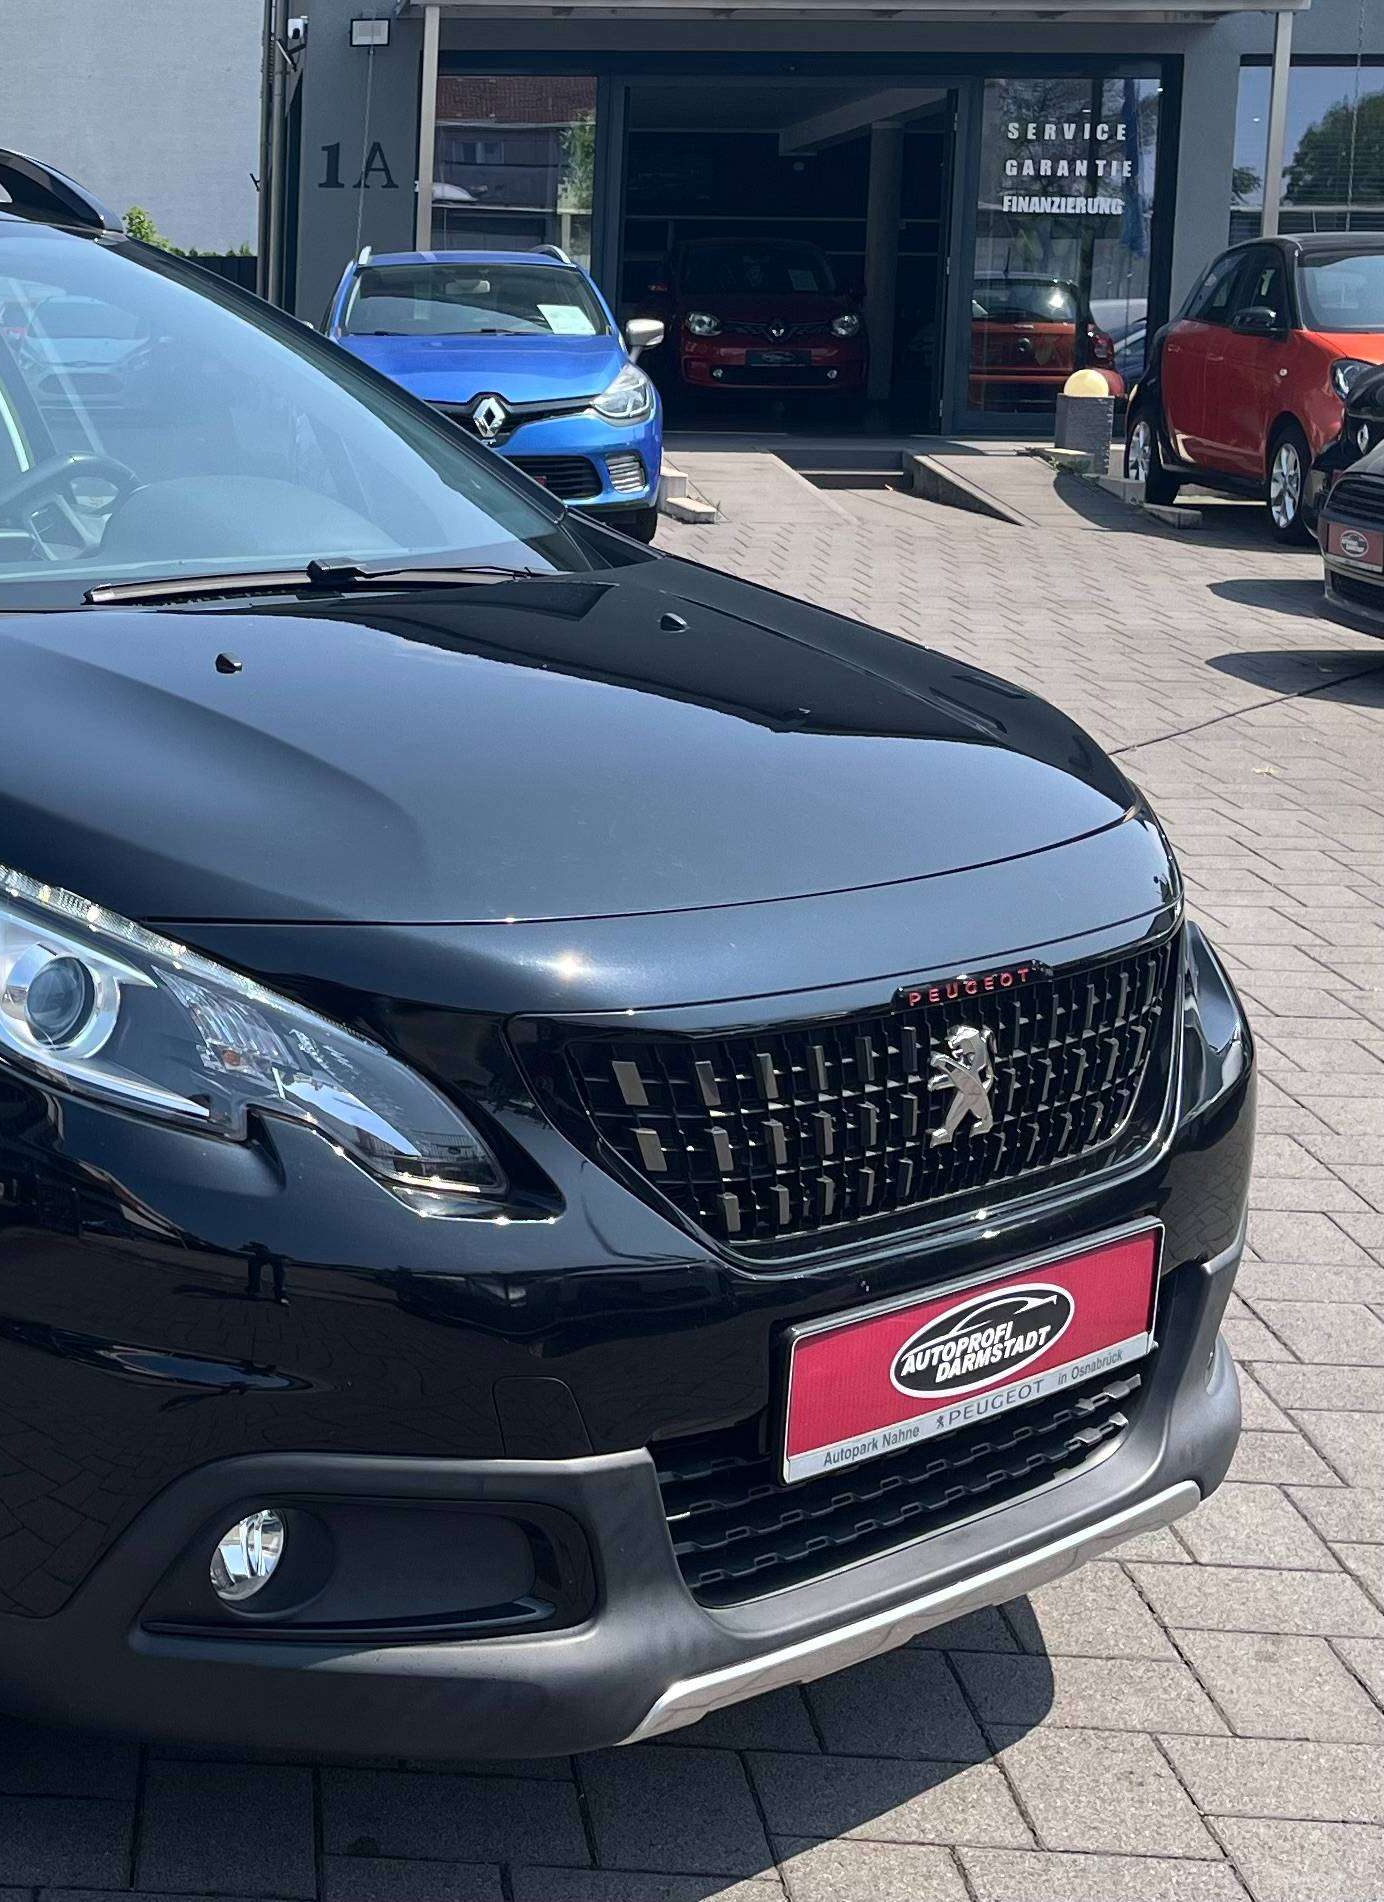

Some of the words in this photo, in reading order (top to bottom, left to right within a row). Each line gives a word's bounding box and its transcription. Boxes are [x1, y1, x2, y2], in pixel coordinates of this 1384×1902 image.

[1007, 122, 1127, 141] SERVICE
[318, 141, 399, 189] 1A
[1005, 159, 1133, 178] GARANTIE
[1002, 195, 1125, 215] FINANZIERUNG
[908, 967, 1030, 1007] PEUGEOT
[901, 1320, 1015, 1377] AUTOPROFI
[935, 1325, 1052, 1384] DARMSTADT
[823, 1437, 879, 1467] Autopark
[881, 1425, 920, 1448] Nahne
[948, 1378, 1045, 1426] PEUGEOT
[1057, 1372, 1067, 1386] in
[1071, 1349, 1123, 1380] Osnabrück
